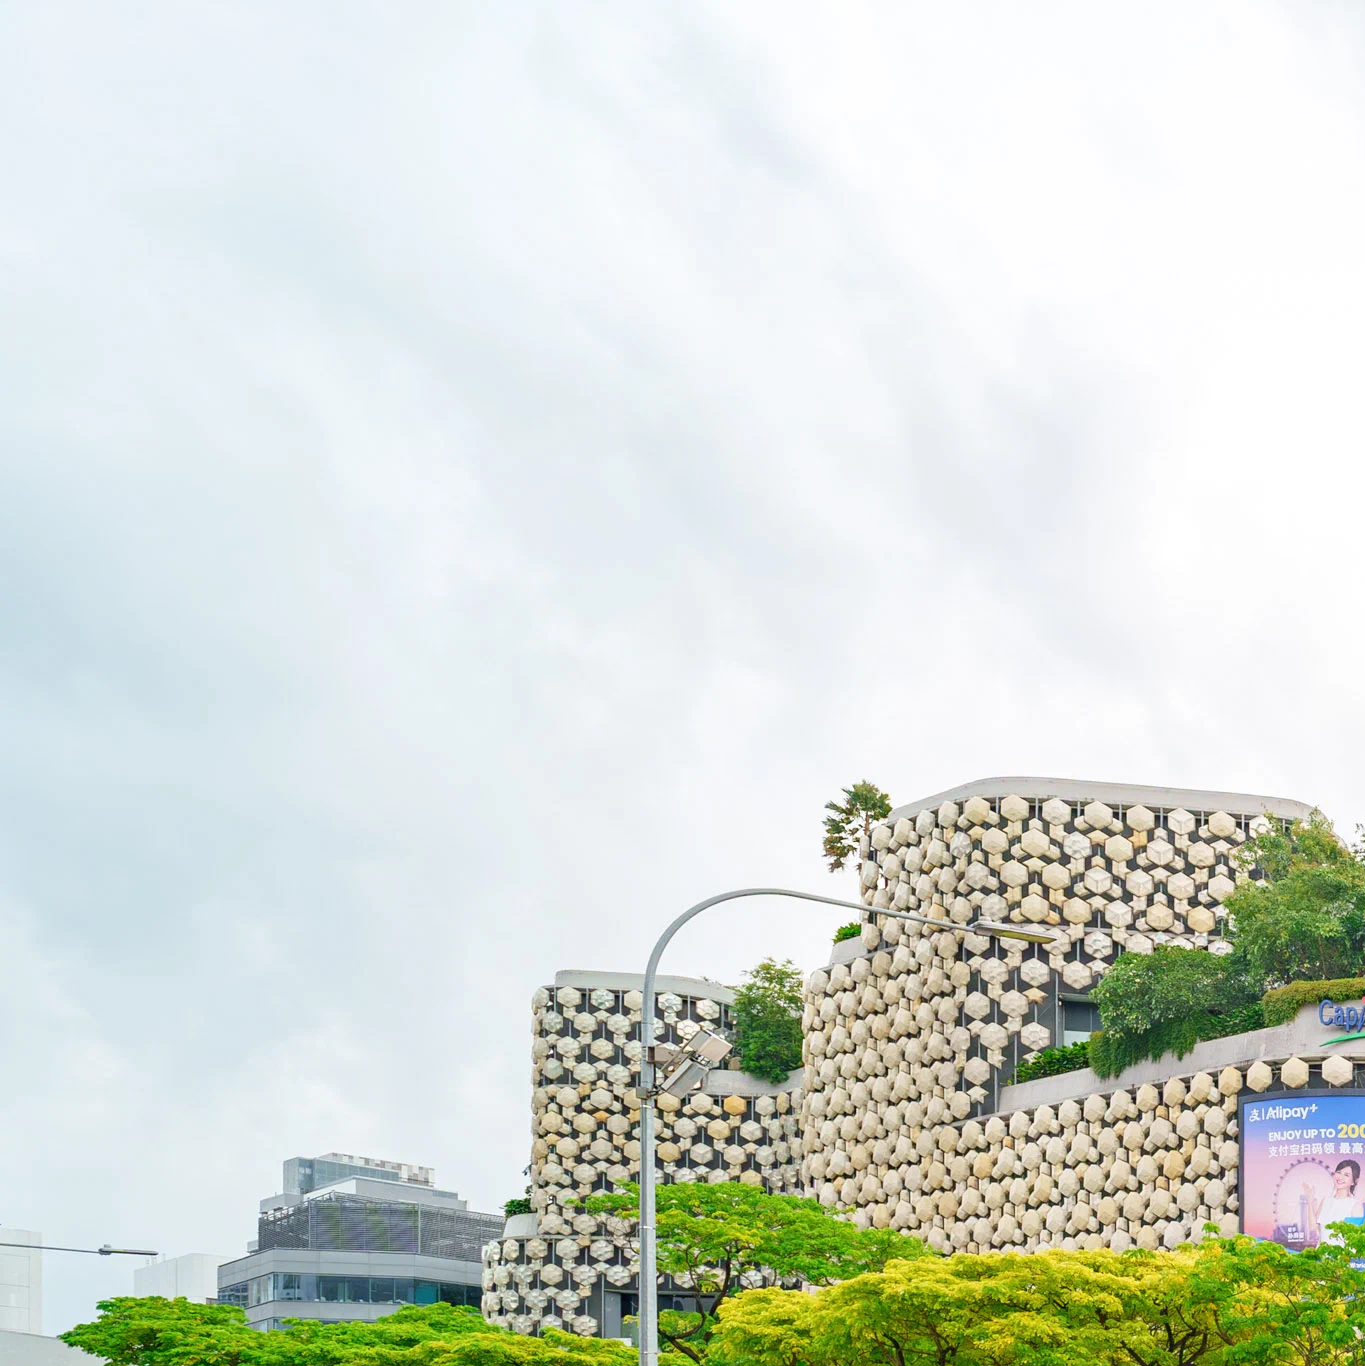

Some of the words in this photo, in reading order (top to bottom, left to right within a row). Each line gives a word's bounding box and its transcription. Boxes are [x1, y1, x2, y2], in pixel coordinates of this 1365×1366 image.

[1268, 1129, 1301, 1142] ENJOY
[1303, 1129, 1319, 1140] UP
[1321, 1128, 1336, 1139] TO
[1268, 1142, 1336, 1158] 支付宝扫码领
